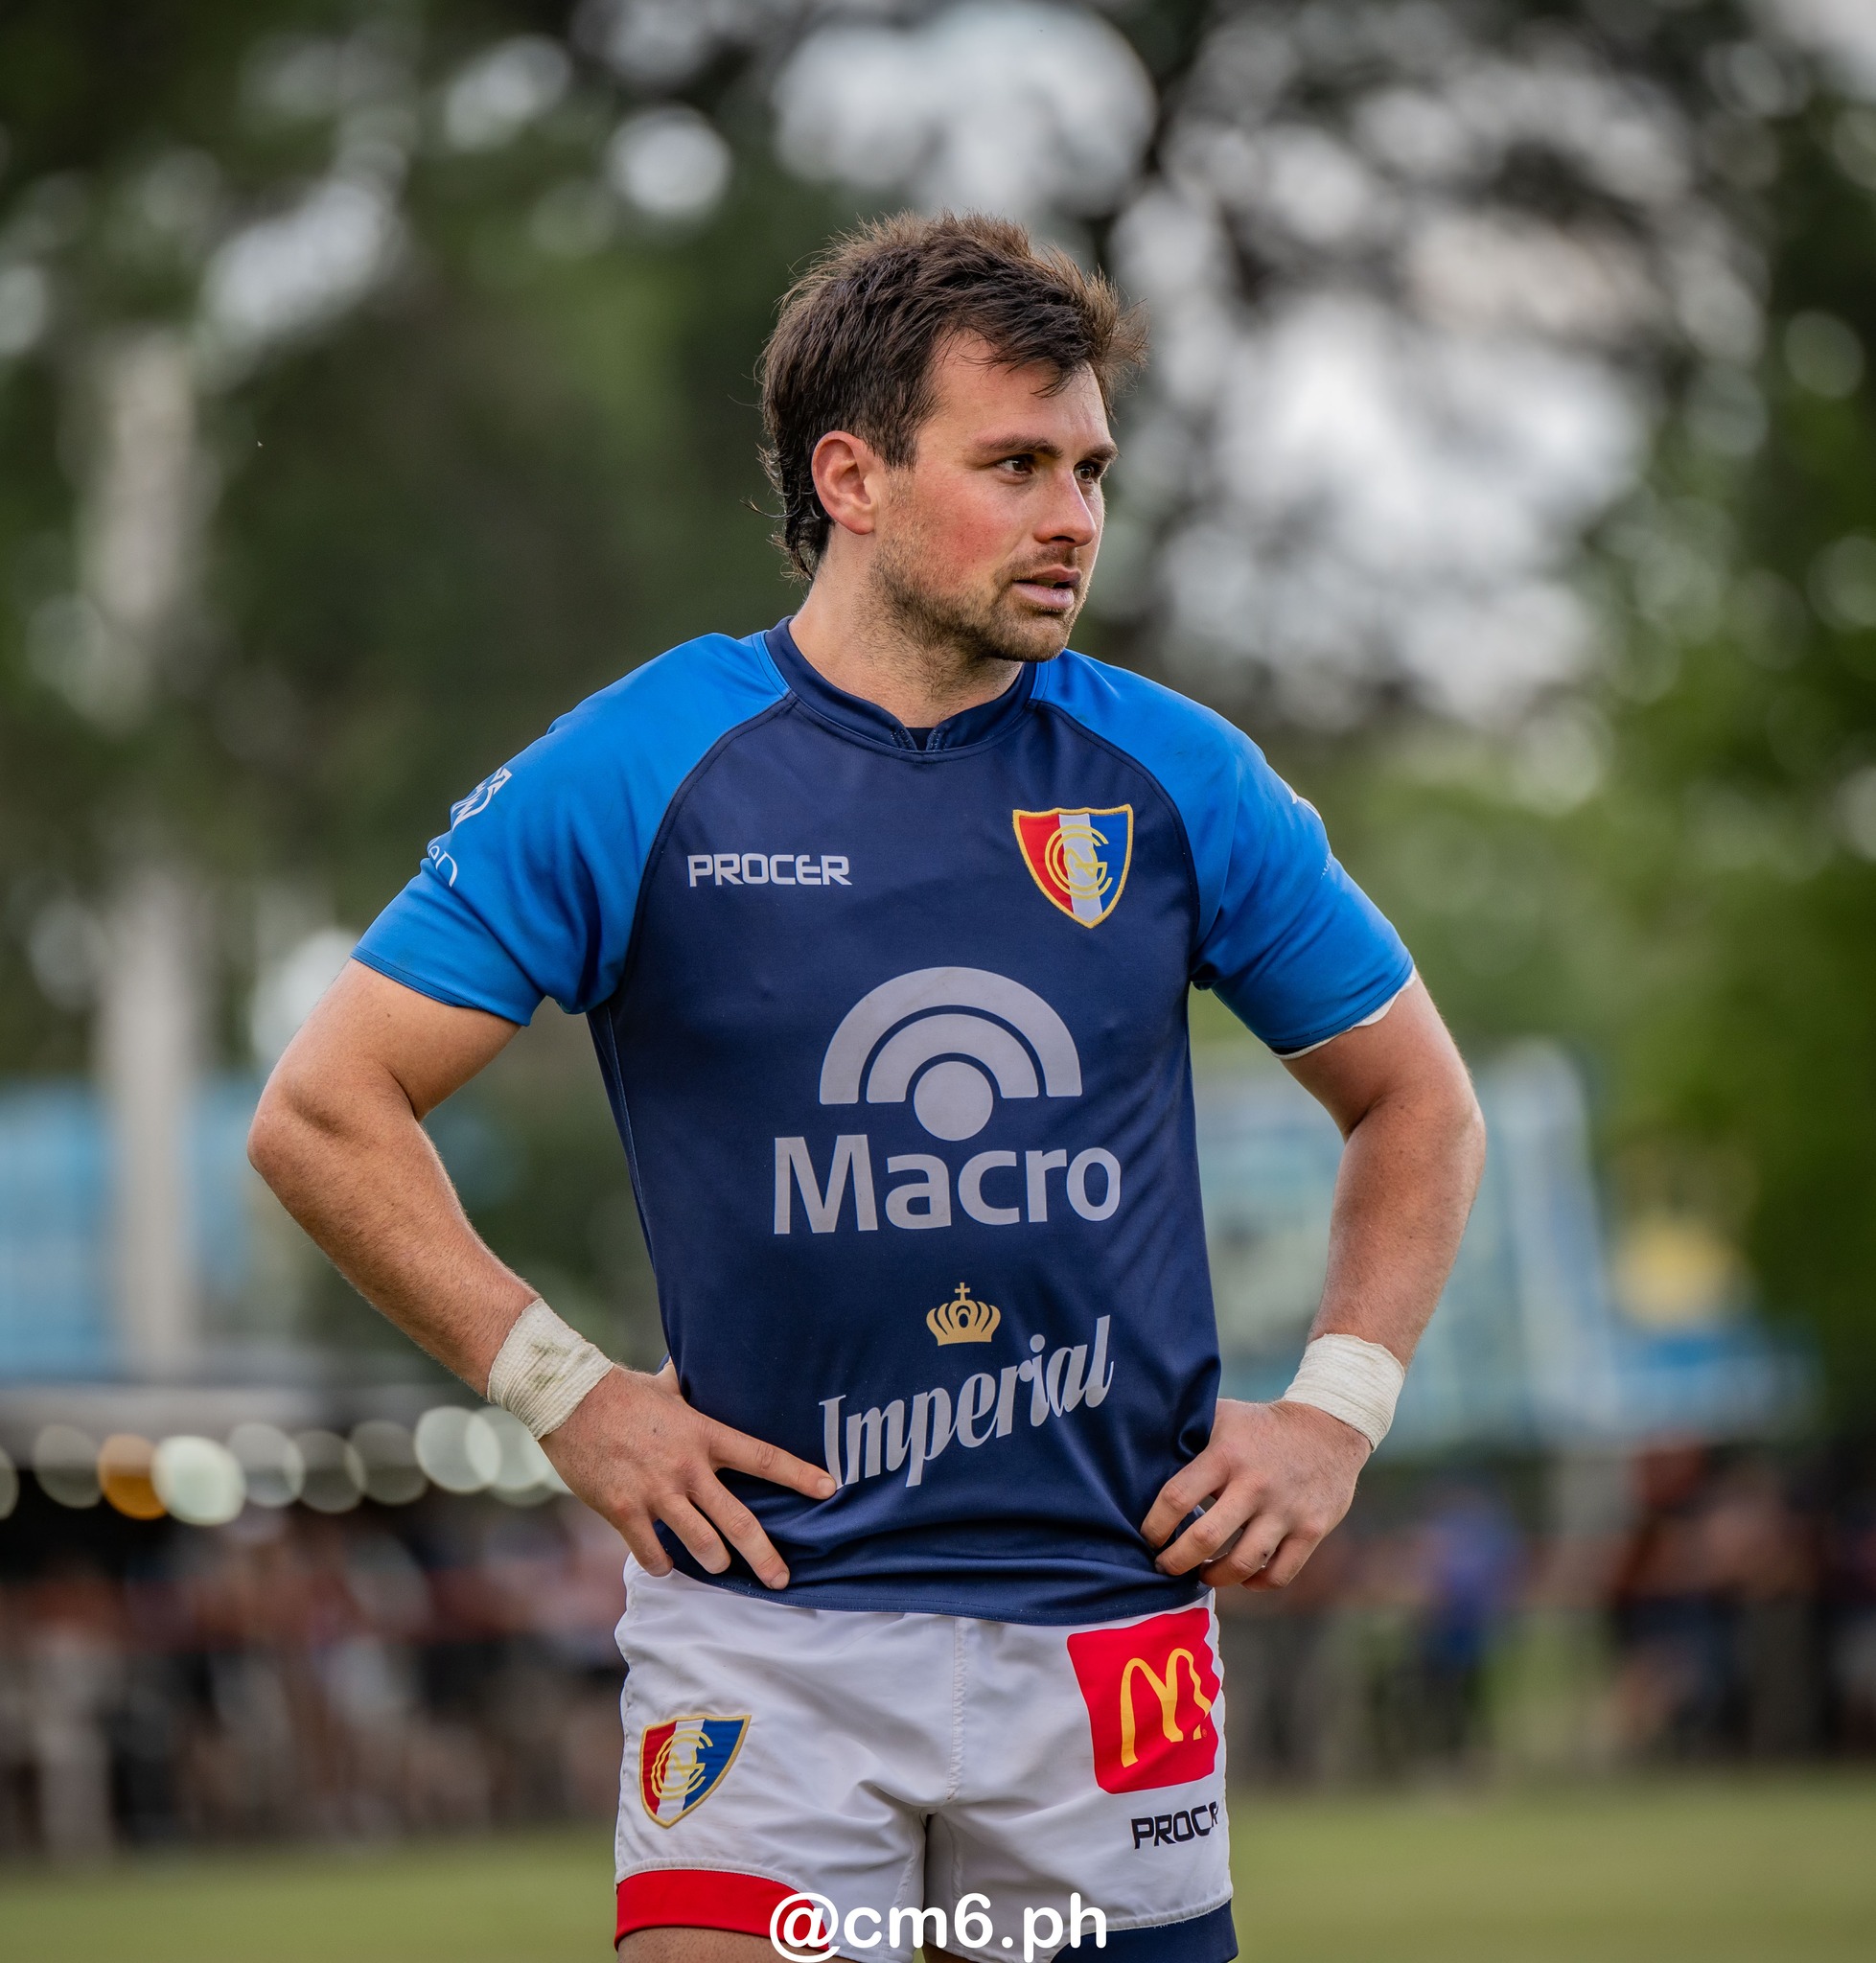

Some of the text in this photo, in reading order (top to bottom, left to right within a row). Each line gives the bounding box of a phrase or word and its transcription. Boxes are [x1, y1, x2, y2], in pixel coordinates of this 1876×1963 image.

[687, 852, 852, 887] PROCER
[774, 1134, 1122, 1235] Macro
[819, 1314, 1115, 1490] Imperial
